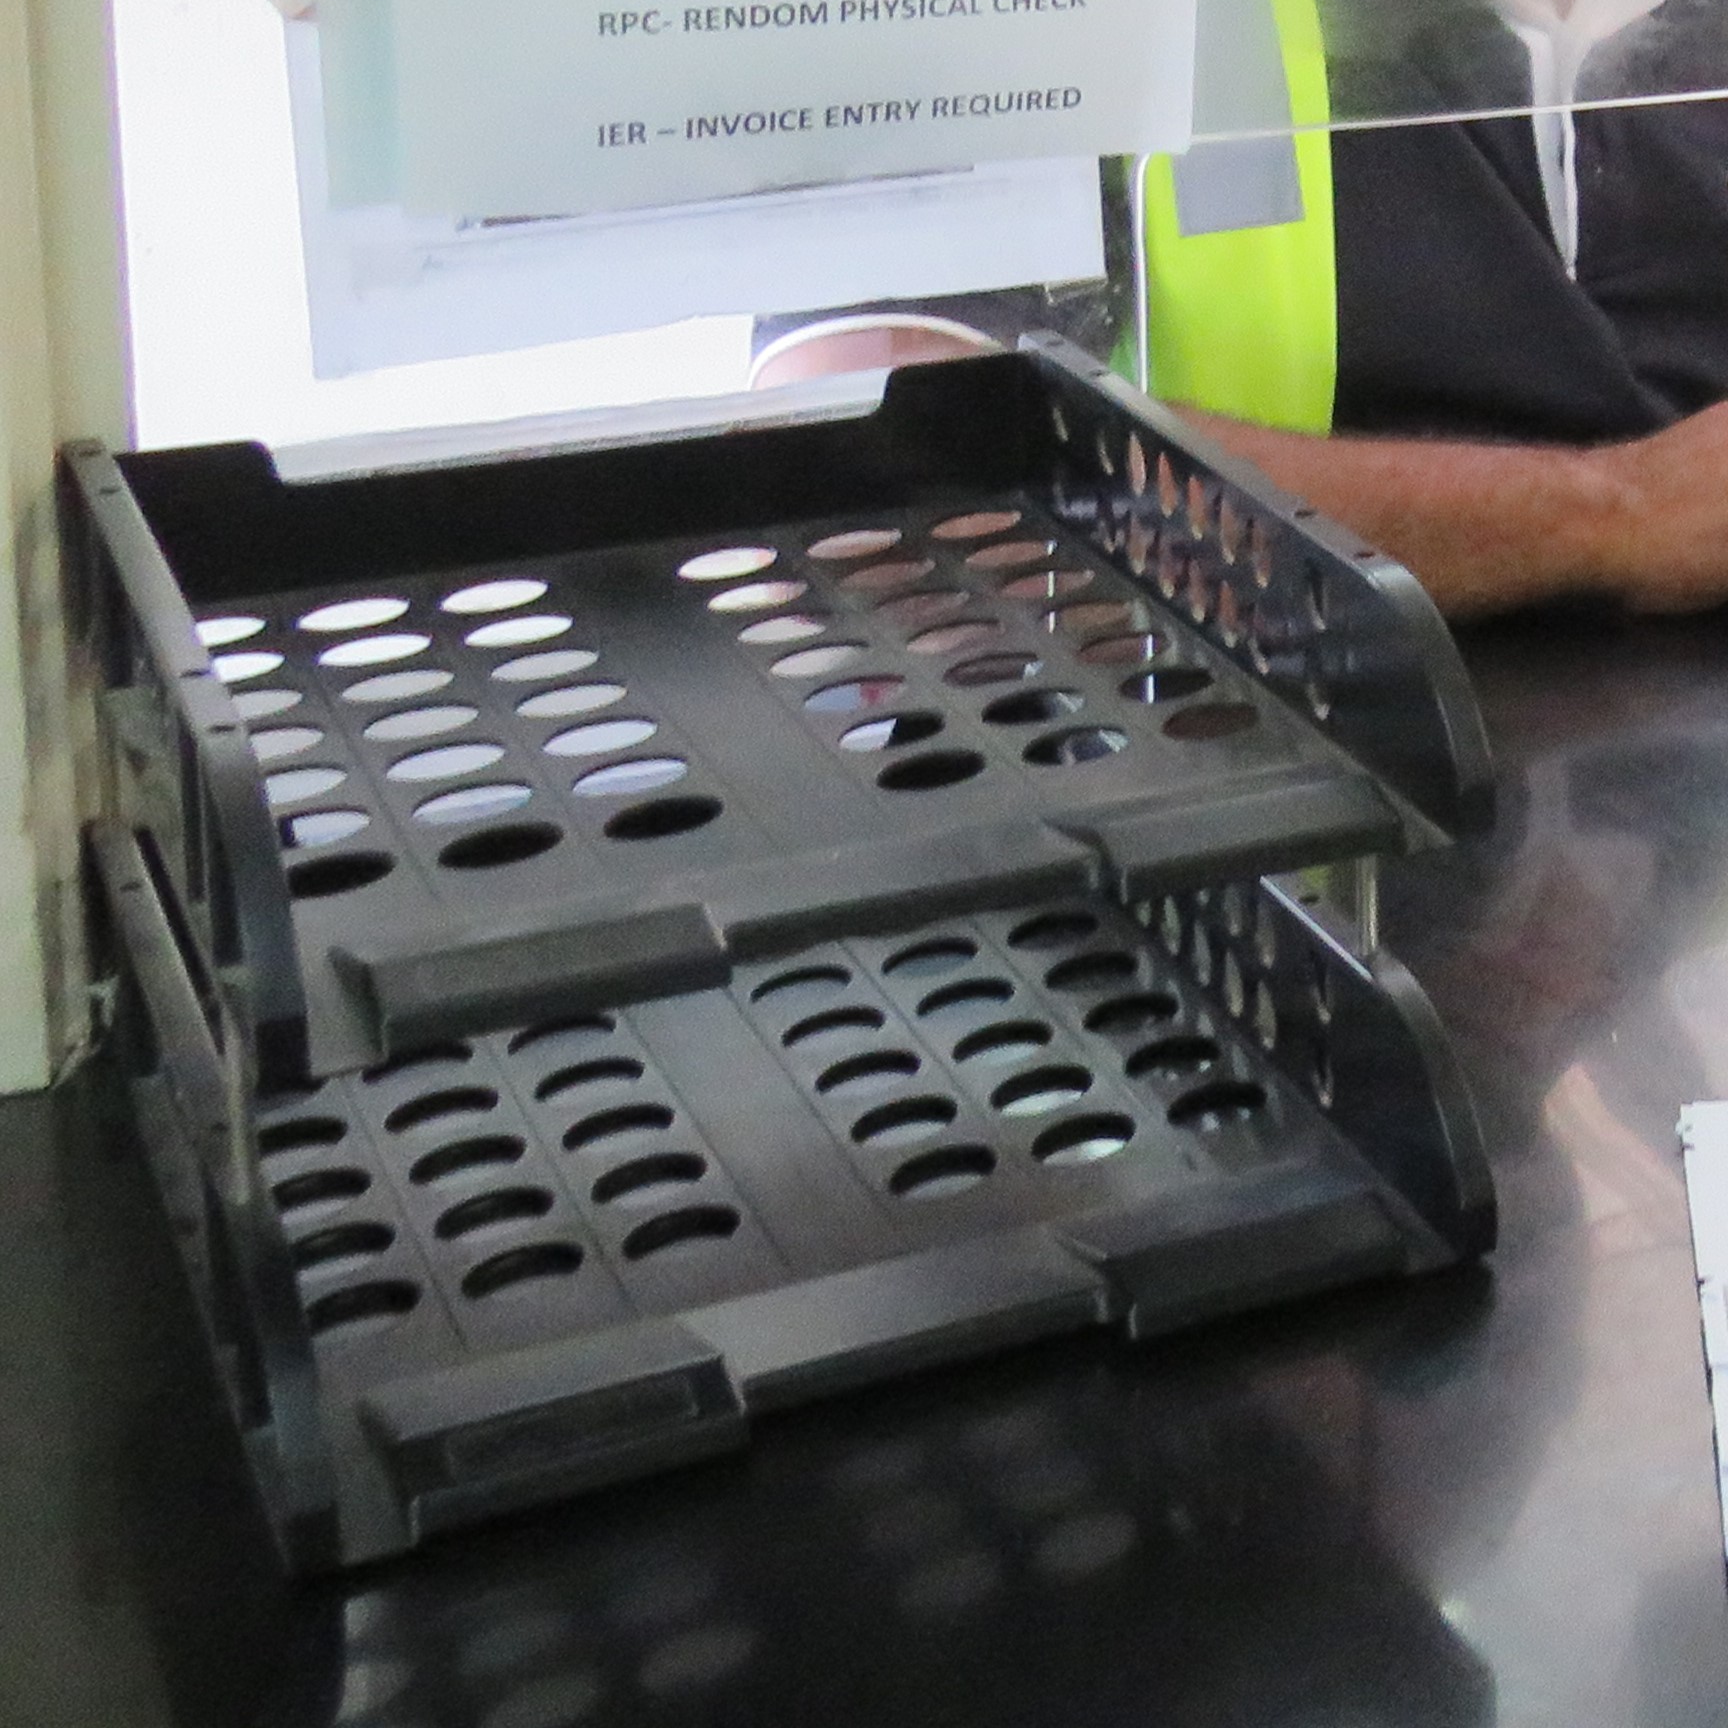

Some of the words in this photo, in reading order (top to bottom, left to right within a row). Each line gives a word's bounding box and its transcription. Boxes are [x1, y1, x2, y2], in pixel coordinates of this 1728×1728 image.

[683, 2, 828, 31] RENDOM
[598, 122, 646, 146] IER
[685, 110, 811, 139] INVOICE
[825, 99, 919, 128] ENTRY
[931, 87, 1081, 117] REQUIRED
